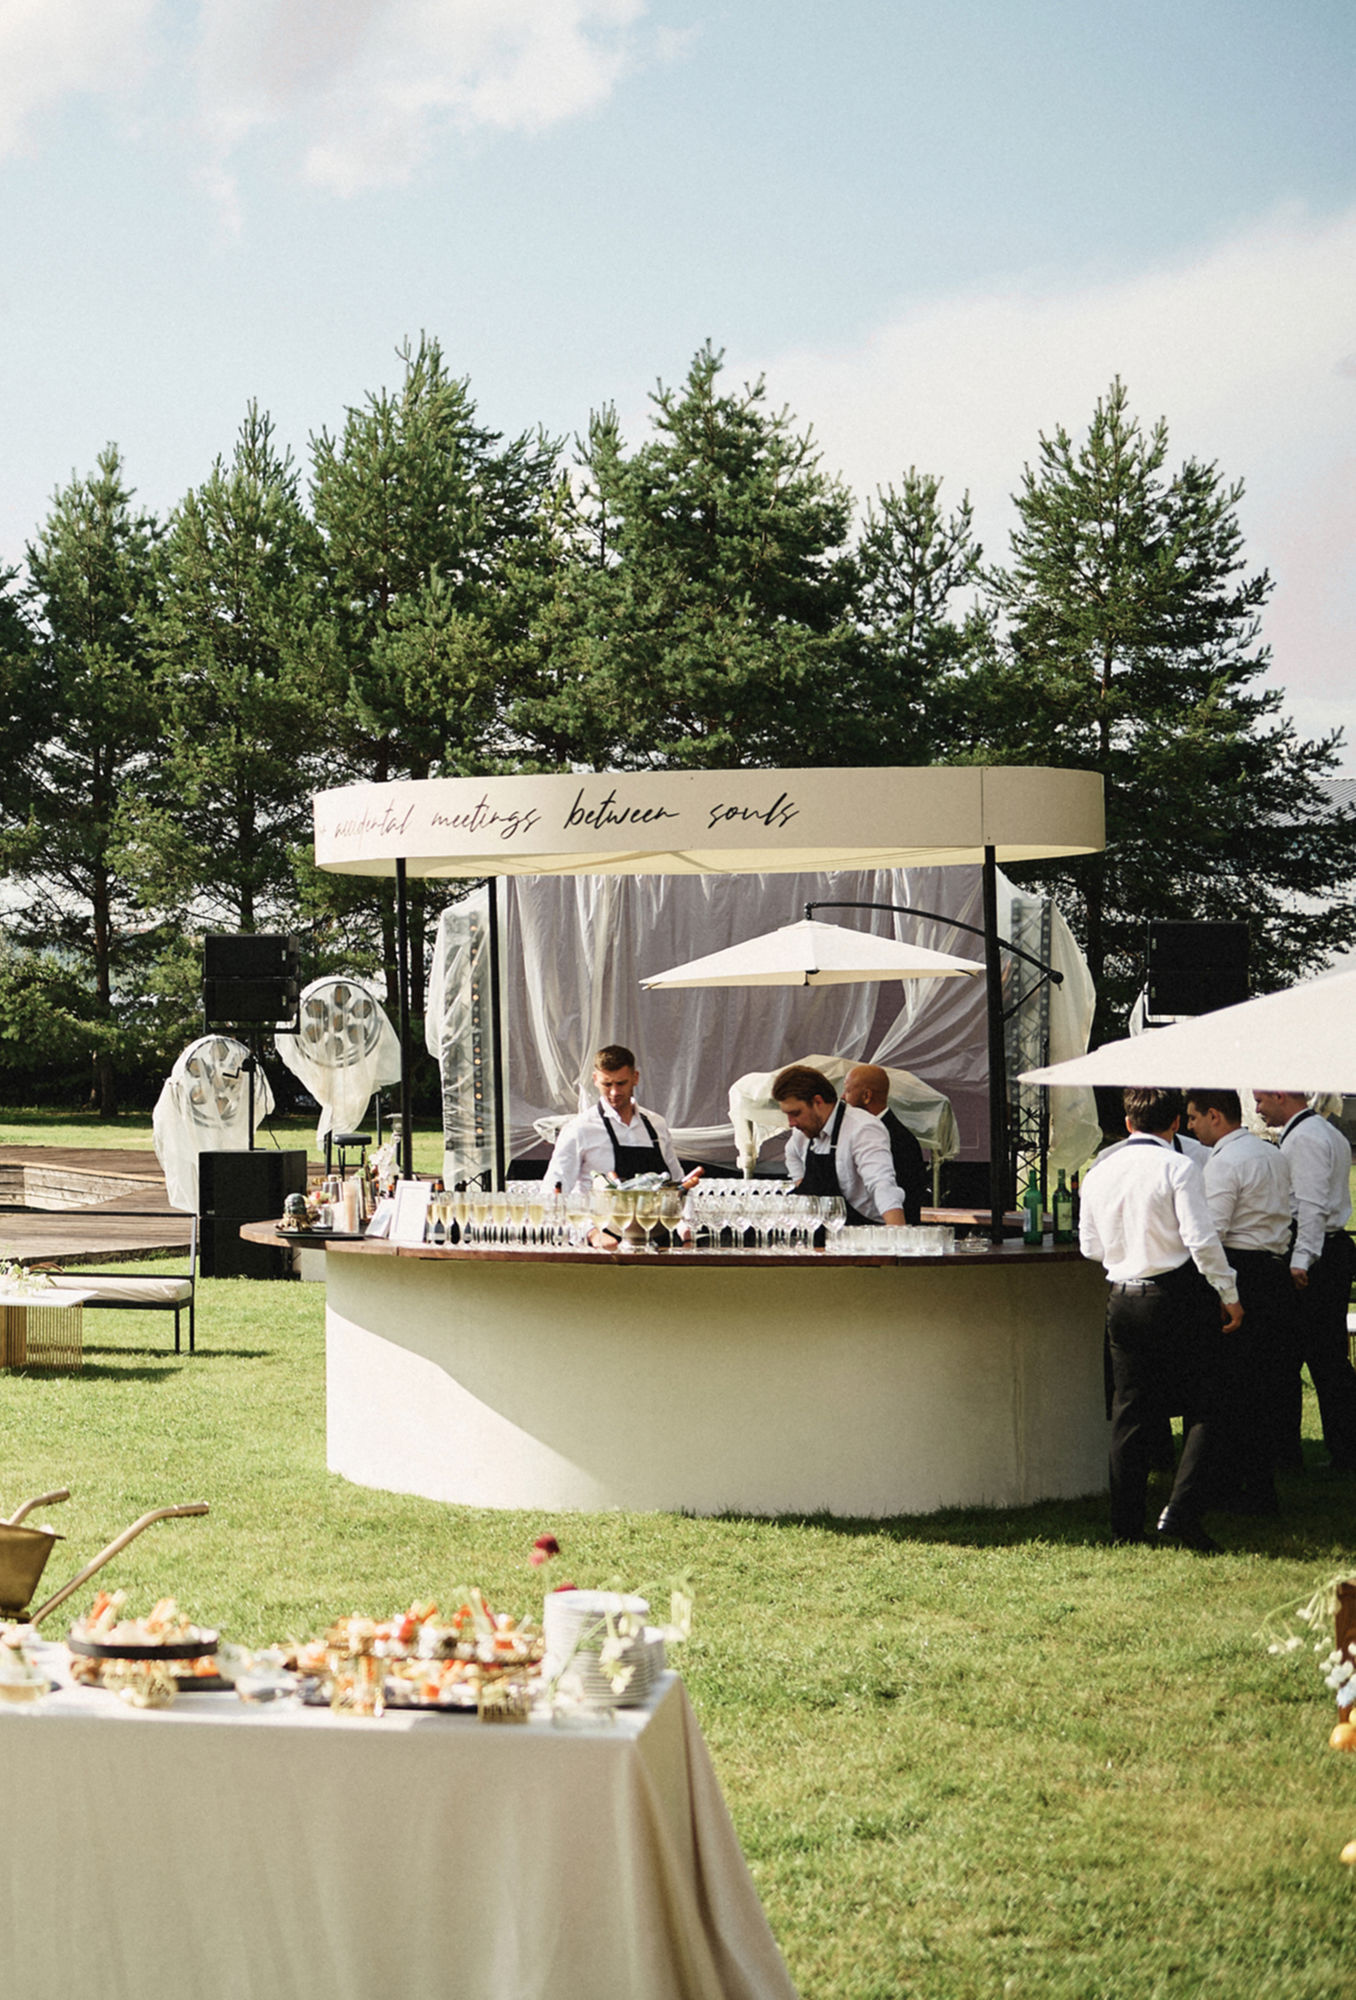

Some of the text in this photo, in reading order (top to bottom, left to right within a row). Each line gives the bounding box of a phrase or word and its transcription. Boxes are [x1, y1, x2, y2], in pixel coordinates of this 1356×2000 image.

[431, 794, 542, 840] meetings
[563, 788, 680, 829] between
[707, 792, 800, 828] souls
